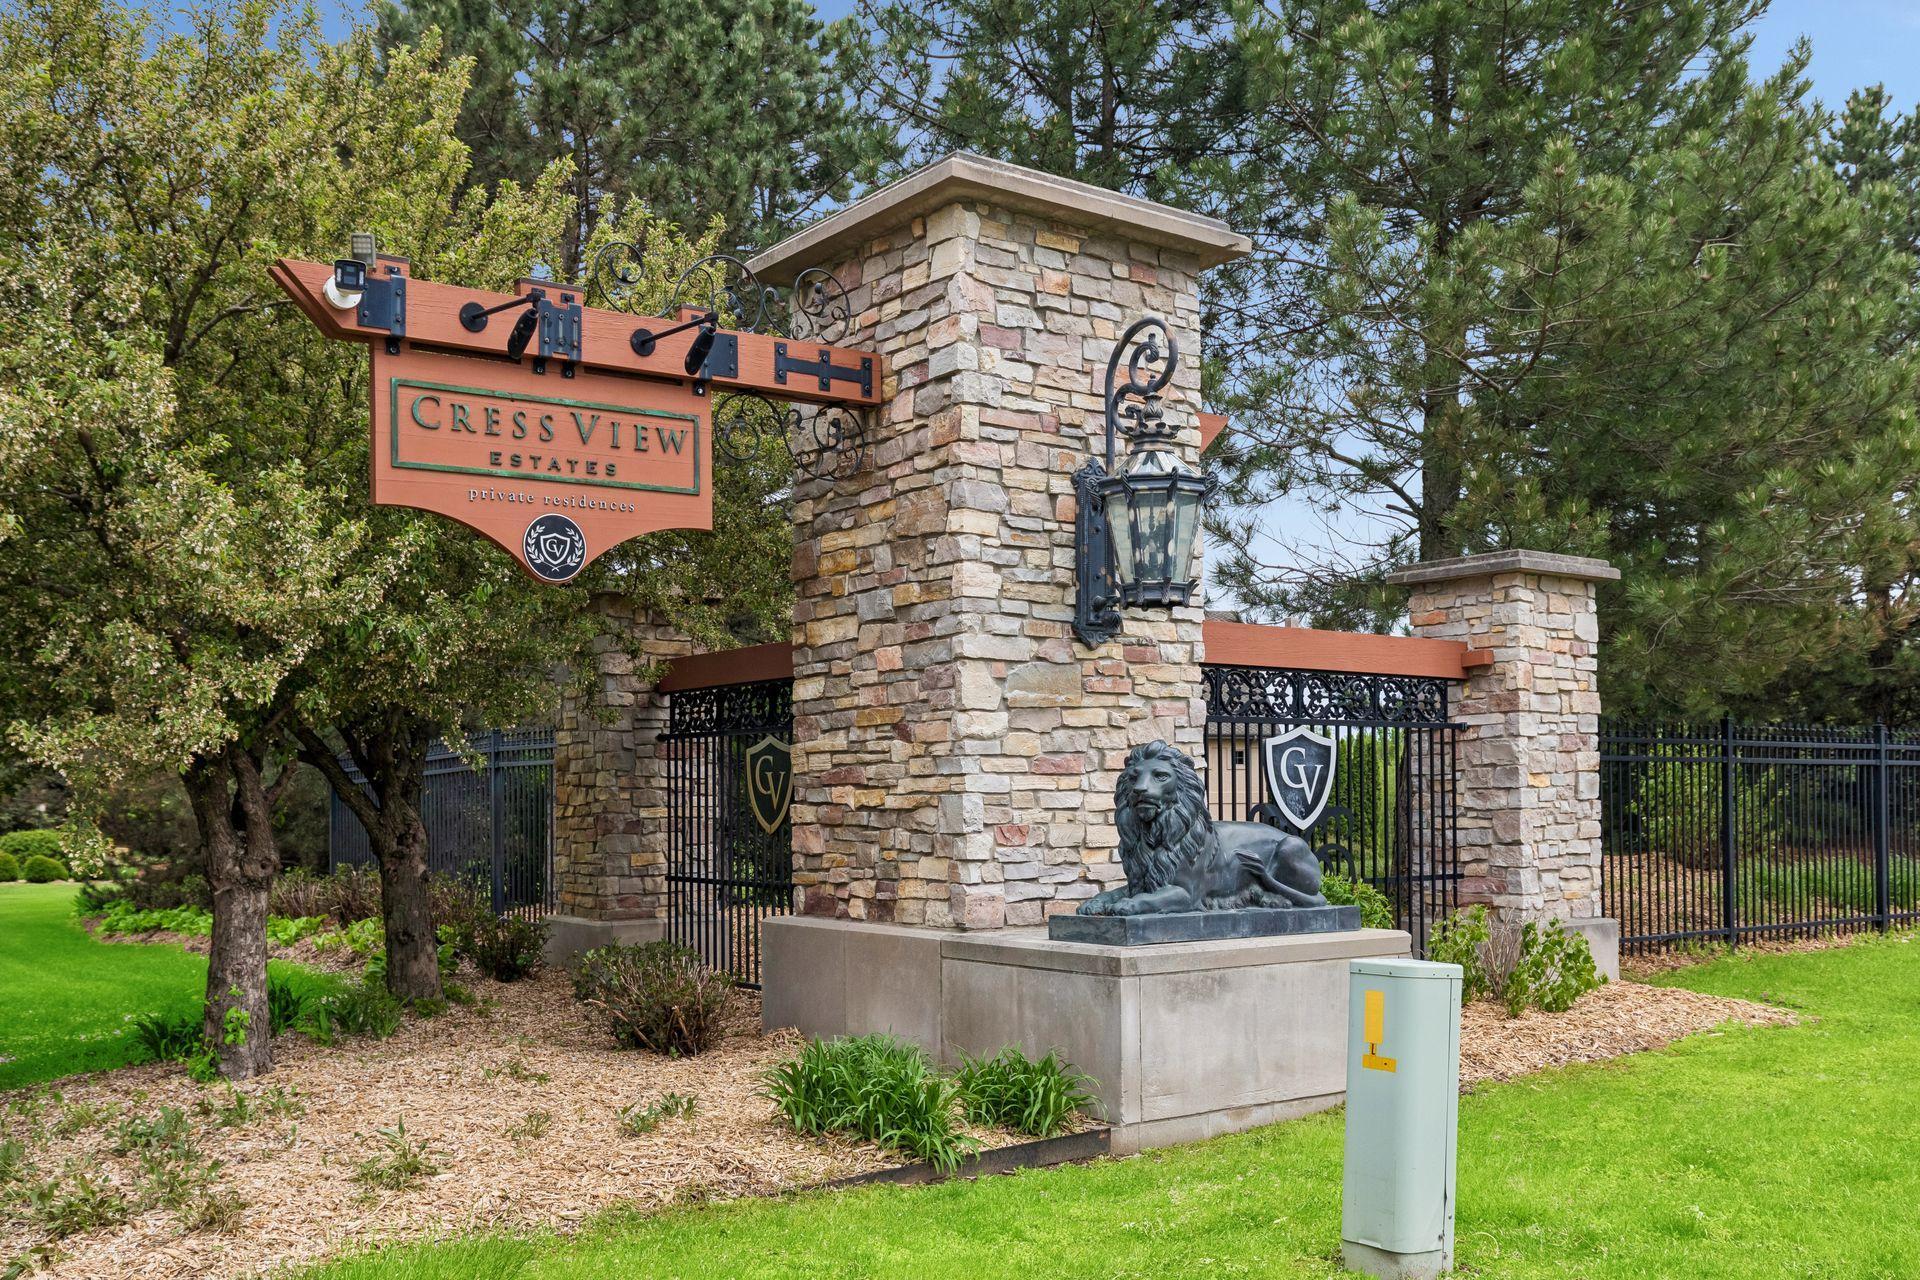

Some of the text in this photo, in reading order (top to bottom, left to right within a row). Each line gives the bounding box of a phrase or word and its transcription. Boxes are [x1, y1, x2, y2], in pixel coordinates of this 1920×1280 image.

[490, 451, 617, 476] ESTATES
[468, 487, 636, 512] private residences
